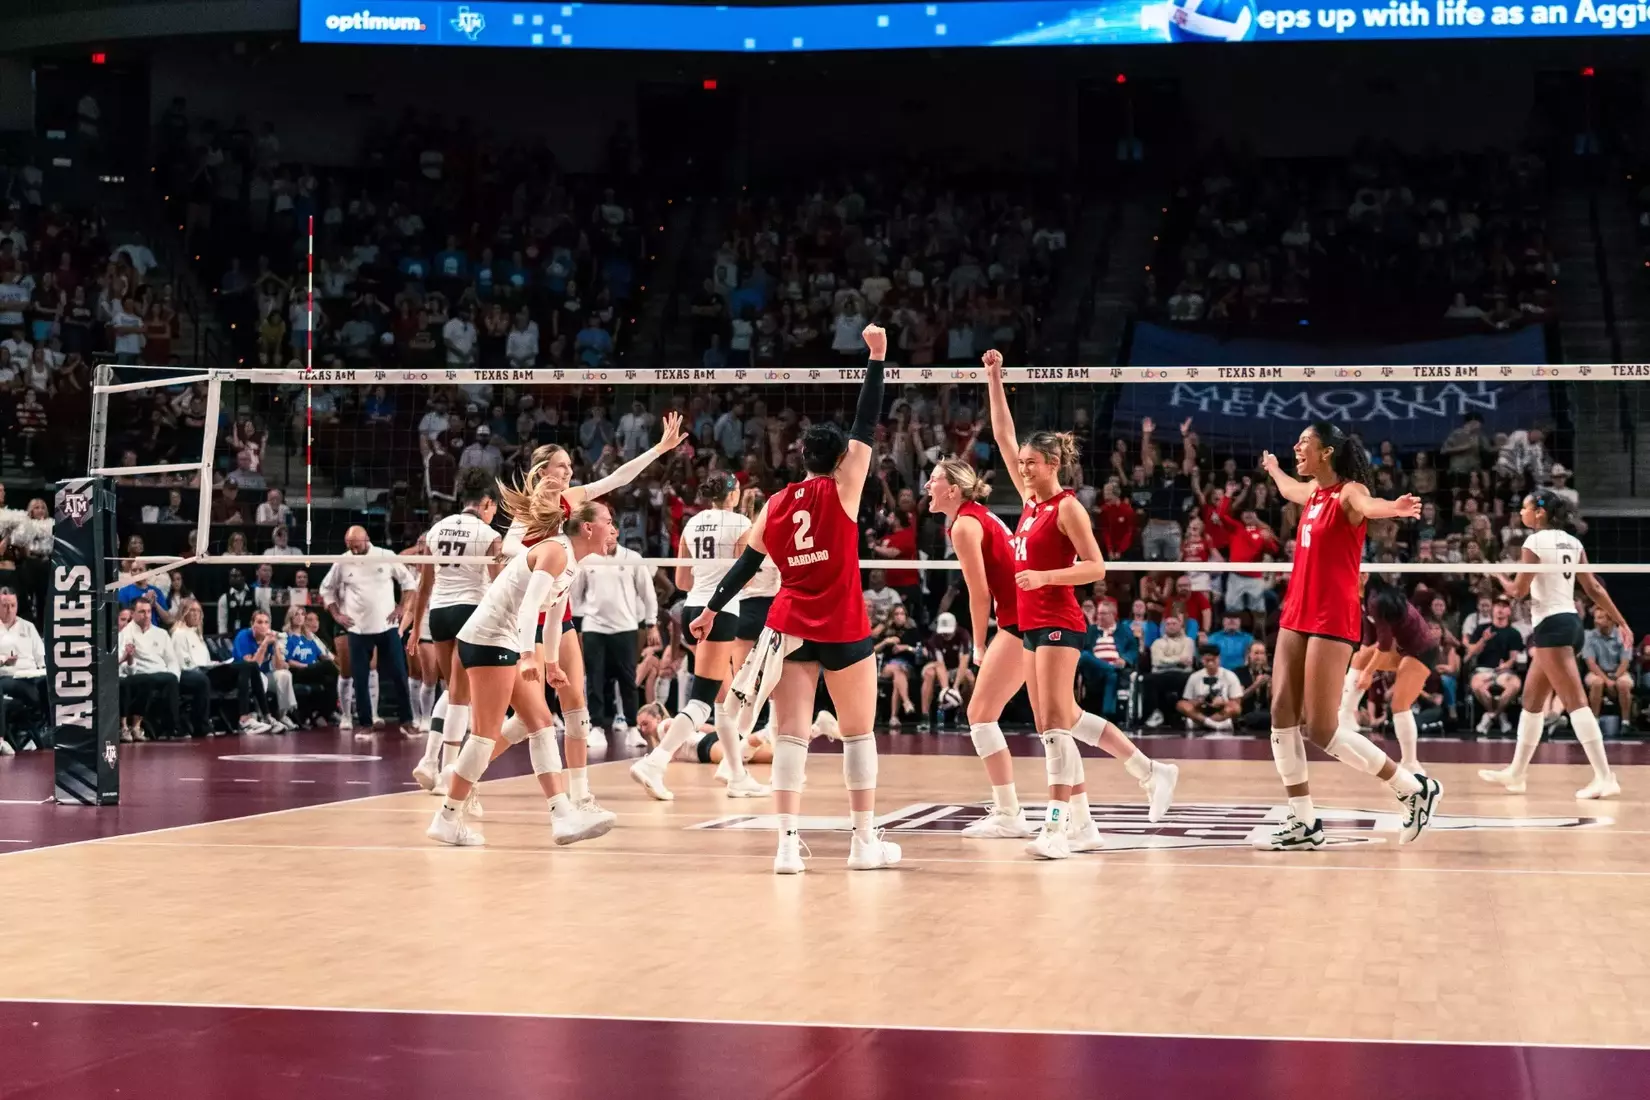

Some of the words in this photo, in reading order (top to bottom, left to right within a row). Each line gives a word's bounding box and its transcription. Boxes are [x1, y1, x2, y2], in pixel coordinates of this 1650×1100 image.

[1256, 8, 1311, 34] eps
[1317, 8, 1357, 33] up
[1362, 0, 1430, 27] with
[1436, 0, 1486, 26] life
[1490, 5, 1525, 25] as
[1530, 4, 1568, 24] an
[1573, 0, 1650, 29] Aggi
[297, 370, 332, 380] TEXAS
[335, 370, 356, 380] A&M
[474, 370, 509, 380] TEXAS
[512, 370, 534, 380] A&M
[654, 370, 690, 380] TEXAS
[693, 370, 715, 380] A&M
[838, 369, 867, 379] TEXA
[883, 369, 901, 379] &M
[1026, 368, 1063, 378] TEXAS
[1067, 368, 1090, 378] A&M
[1217, 367, 1256, 378] TEXAS
[1259, 367, 1283, 378] A&M
[1412, 366, 1451, 377] TEXAS
[1454, 366, 1479, 377] A&M
[1611, 365, 1650, 376] TEXAS
[1169, 381, 1504, 408] MEMORIAL
[1170, 393, 1498, 421] HERMANN
[695, 524, 718, 532] CASTLE
[792, 509, 814, 551] 2
[1301, 523, 1313, 548] 16
[438, 540, 467, 568] 37
[693, 535, 715, 559] 19
[787, 549, 830, 567] BARDARO
[53, 564, 93, 730] AGGIES
